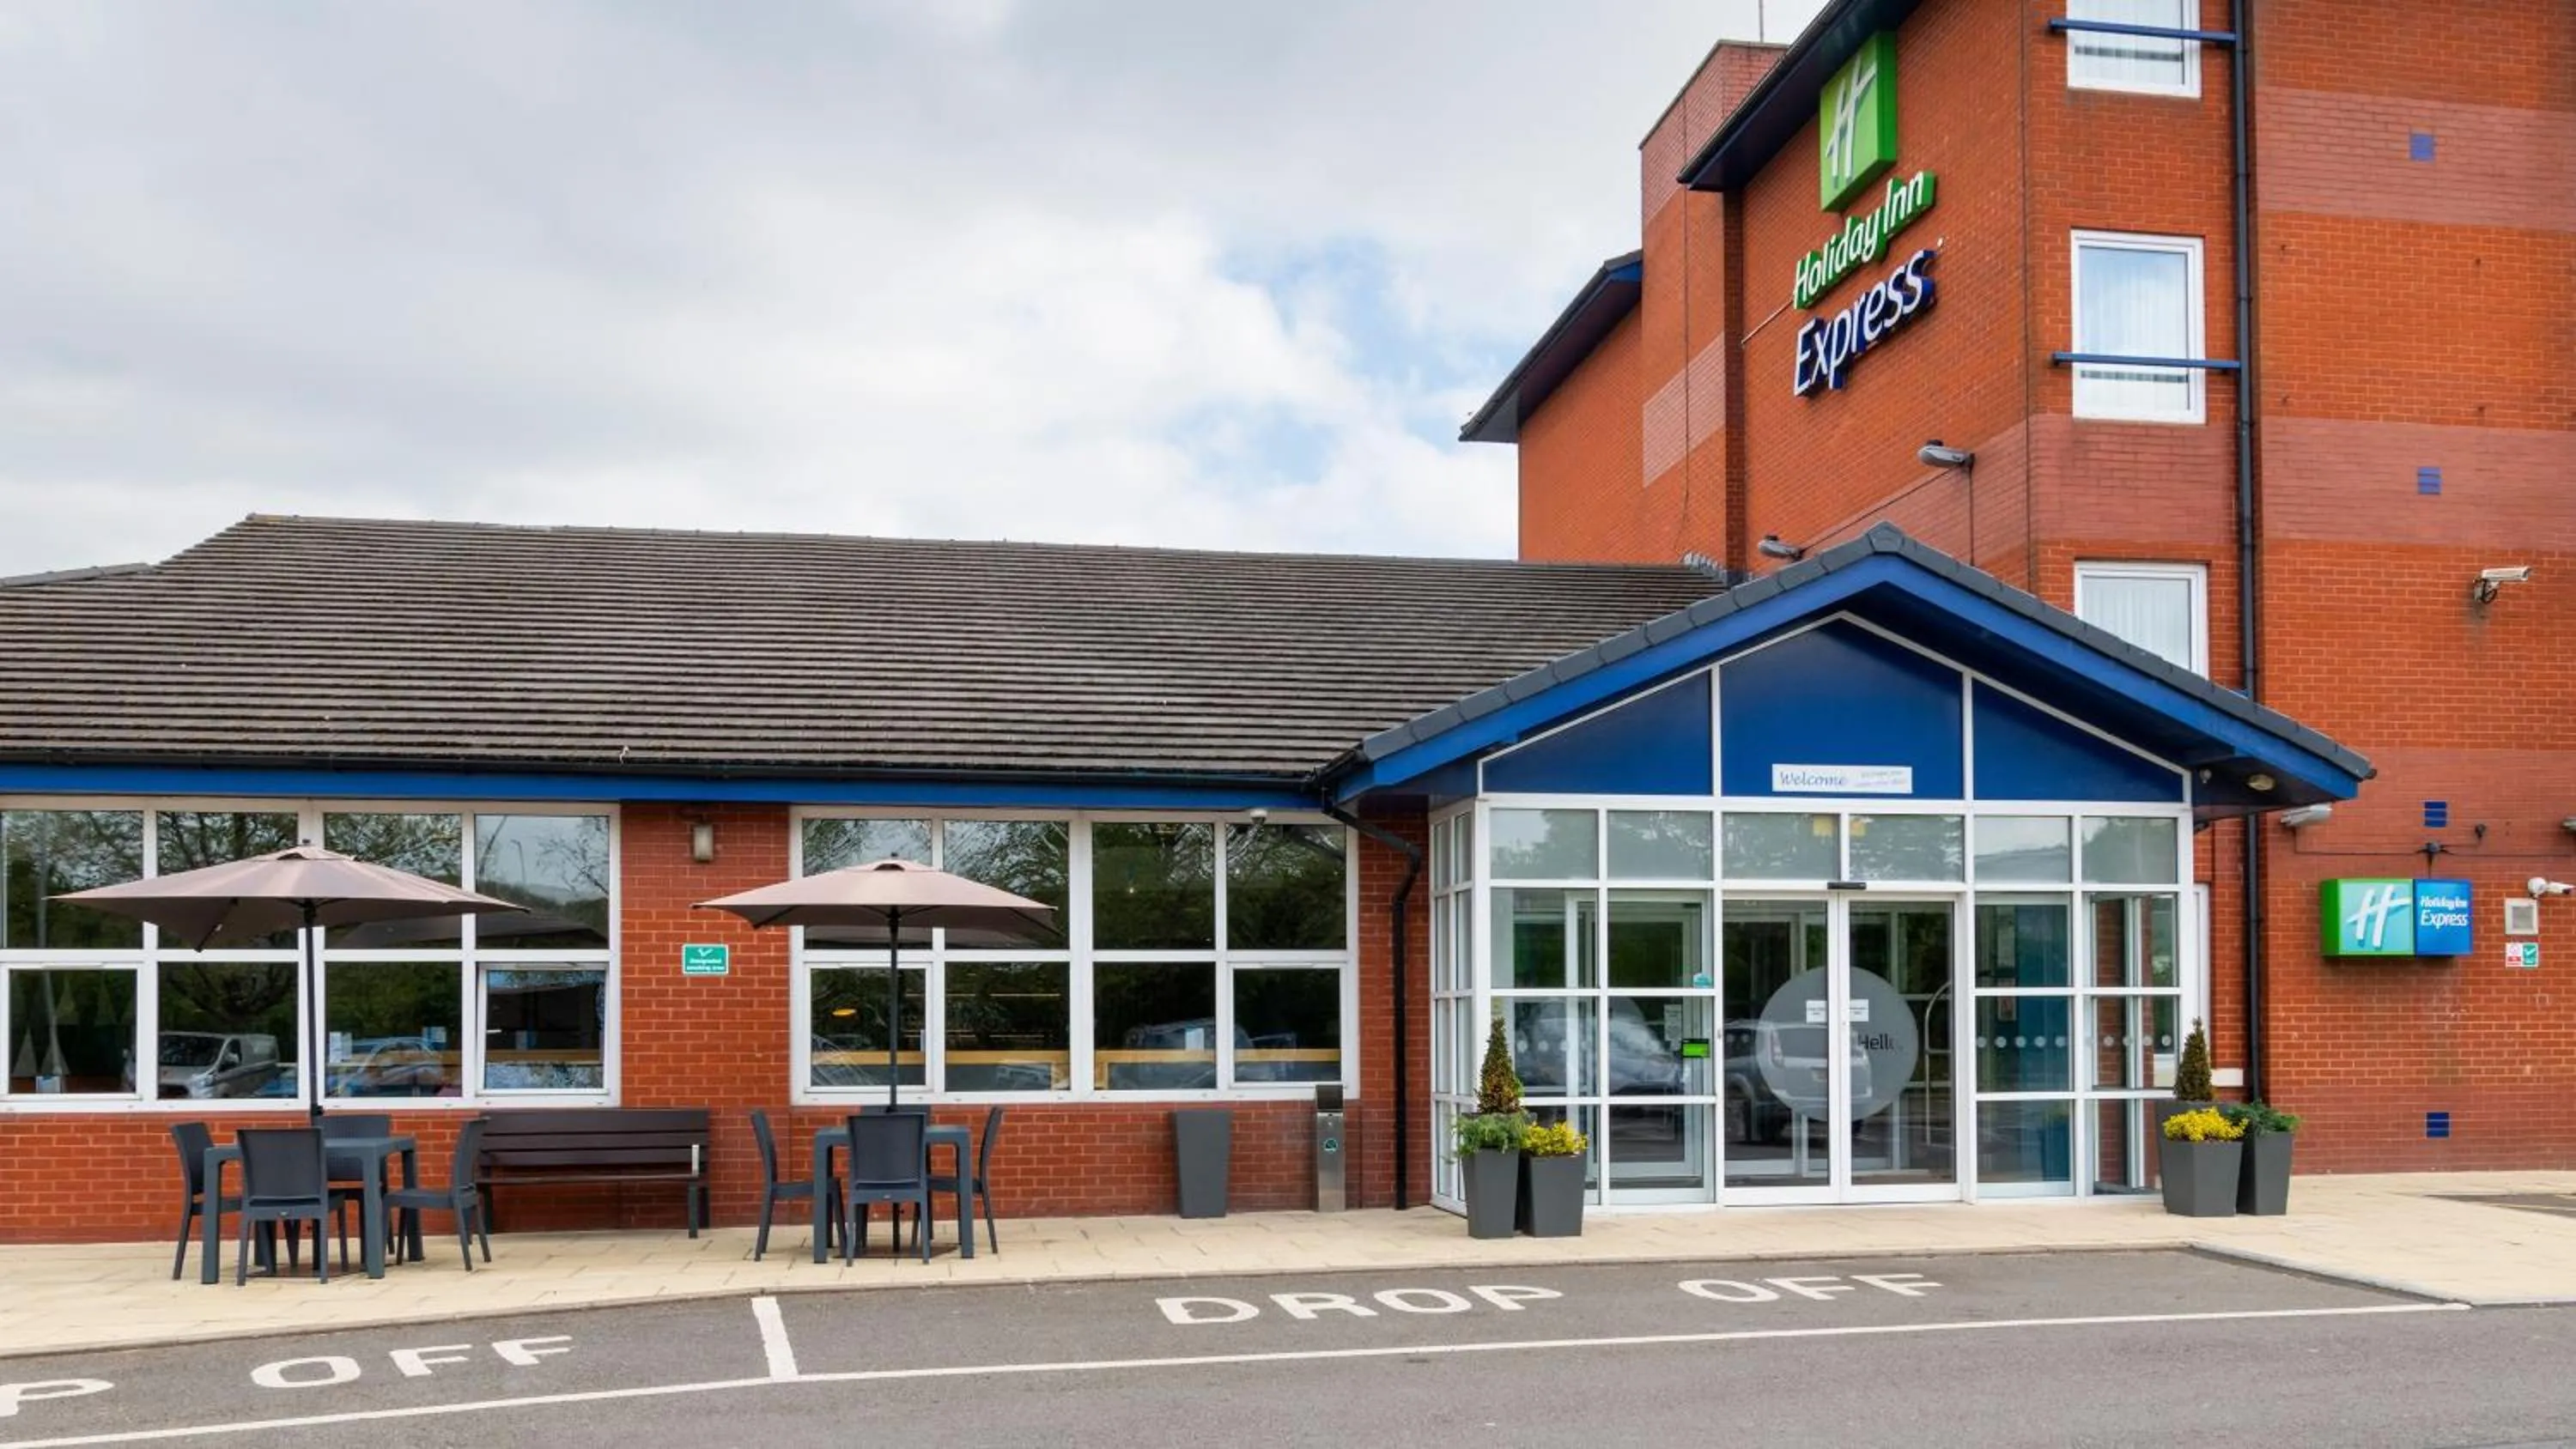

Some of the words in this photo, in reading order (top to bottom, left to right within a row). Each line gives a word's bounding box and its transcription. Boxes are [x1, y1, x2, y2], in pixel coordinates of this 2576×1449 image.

[1793, 208, 1882, 309] Holiday
[1883, 172, 1925, 235] Inn
[1793, 249, 1929, 397] Express
[1779, 771, 1848, 789] Welcome
[2420, 895, 2455, 911] Holiday
[2420, 909, 2469, 930] Express
[1155, 1284, 1564, 1325] DROP
[1678, 1274, 1942, 1302] OFF
[250, 1335, 573, 1388] OFF
